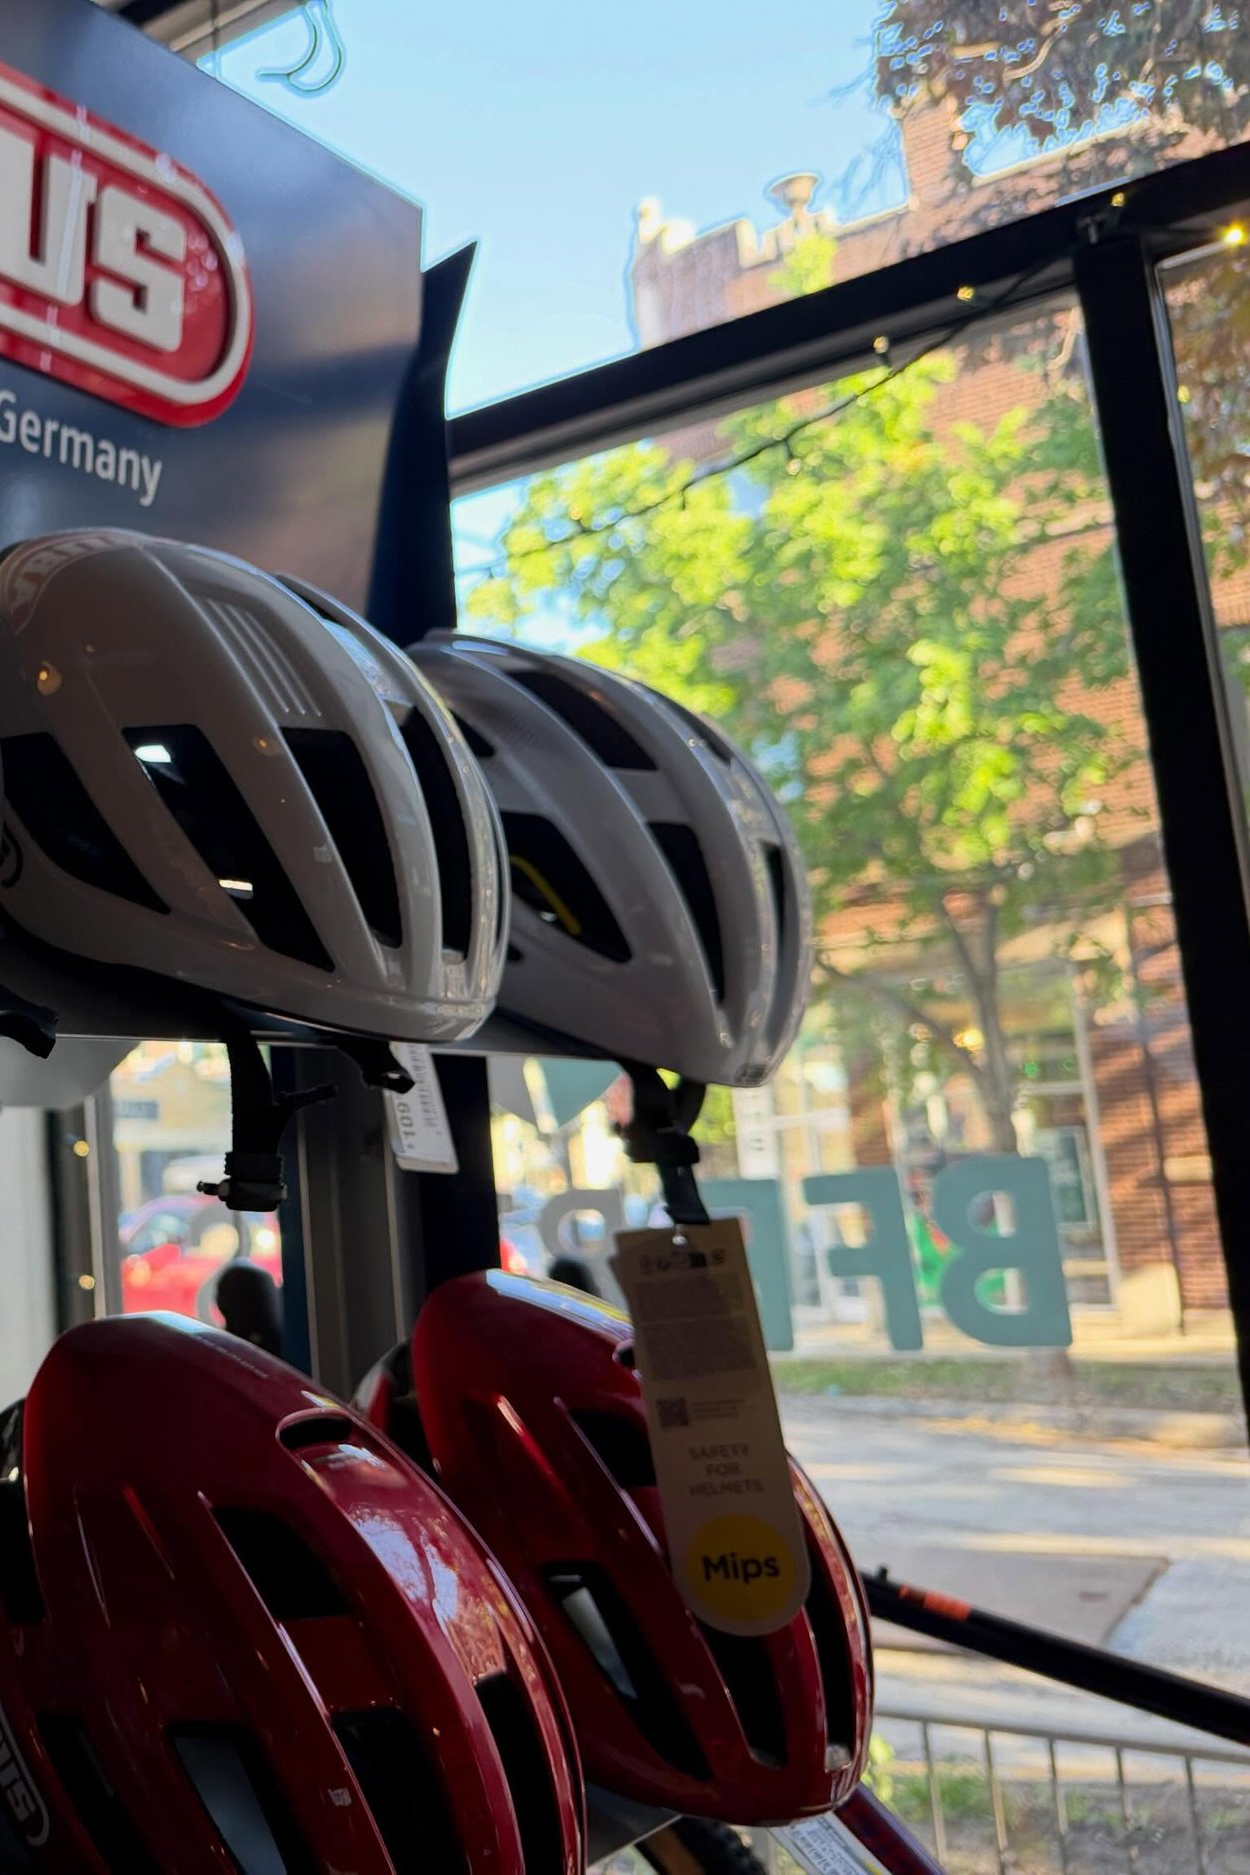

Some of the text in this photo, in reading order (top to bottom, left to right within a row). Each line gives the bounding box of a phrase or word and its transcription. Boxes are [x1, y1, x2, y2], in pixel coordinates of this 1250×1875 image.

[689, 1444, 749, 1461] SAFETY
[706, 1463, 740, 1477] FOR
[689, 1479, 764, 1497] HELMETS
[701, 1552, 781, 1584] Mips
